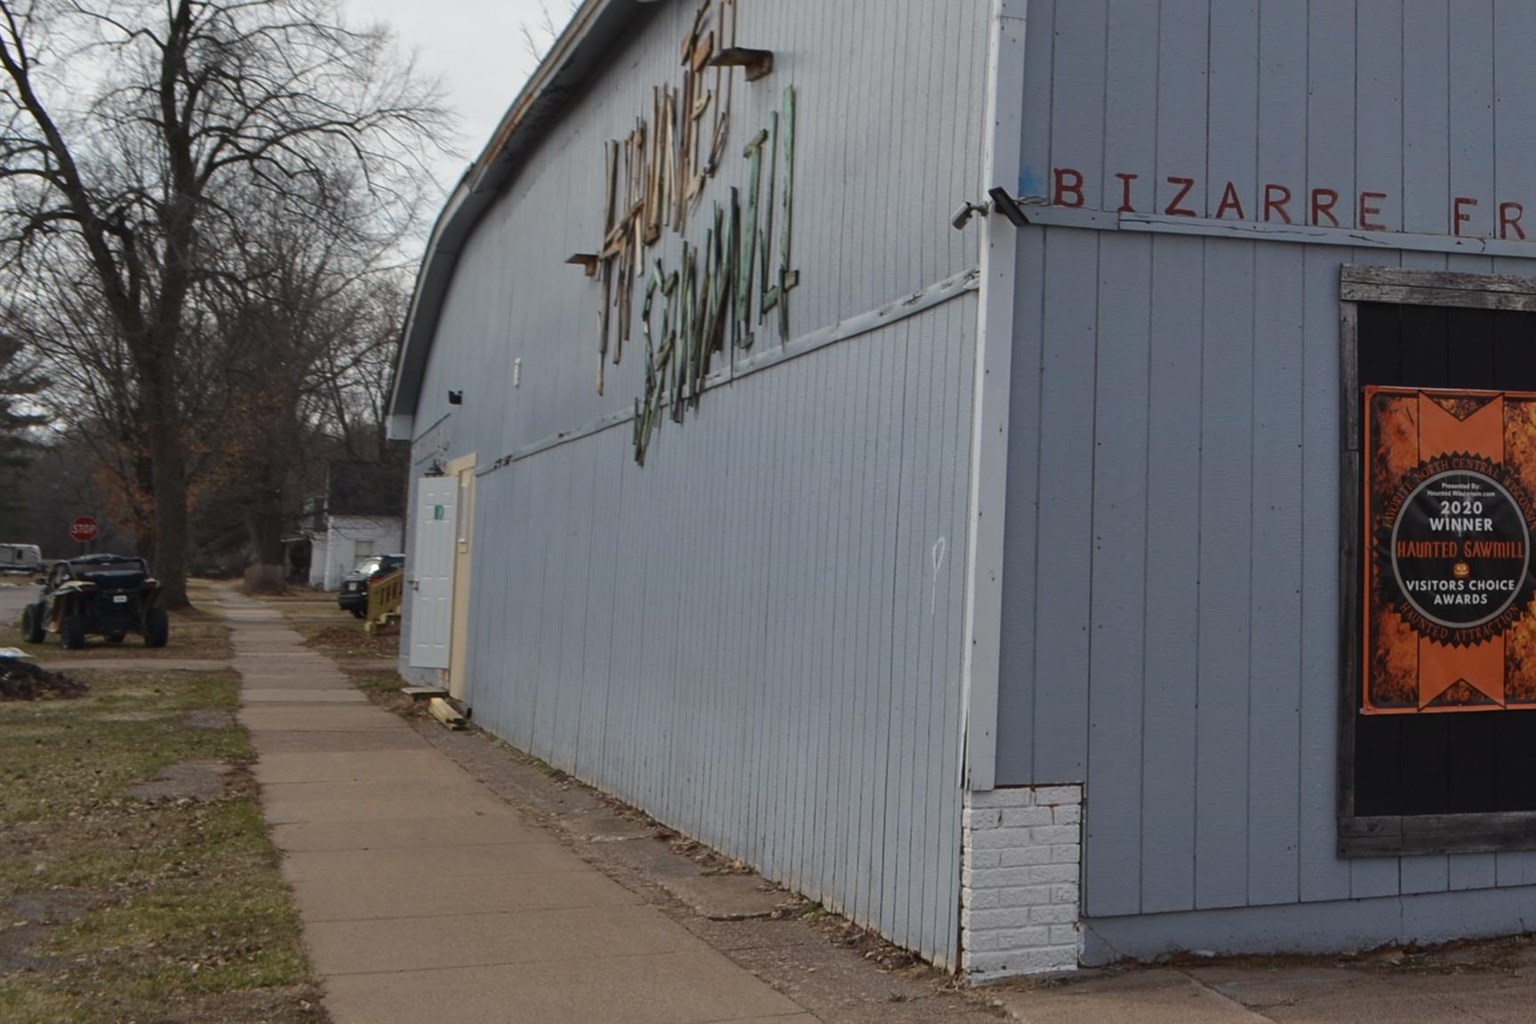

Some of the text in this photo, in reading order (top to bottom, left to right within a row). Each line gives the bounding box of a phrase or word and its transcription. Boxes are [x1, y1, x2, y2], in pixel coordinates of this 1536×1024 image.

[1053, 168, 1387, 231] BIZARRE
[1382, 480, 1414, 528] FAVORITE
[1415, 459, 1450, 485] NORTH
[1452, 458, 1500, 479] CENTRAL
[1440, 501, 1483, 515] 2020
[72, 524, 97, 534] STOP
[1429, 517, 1494, 532] WINNER
[1397, 540, 1458, 558] HAUNTED
[1406, 580, 1515, 591] VISITORS CHOICE
[1433, 593, 1488, 605] AWARDS
[1400, 602, 1521, 641] HAUNTED ATTRACTION
